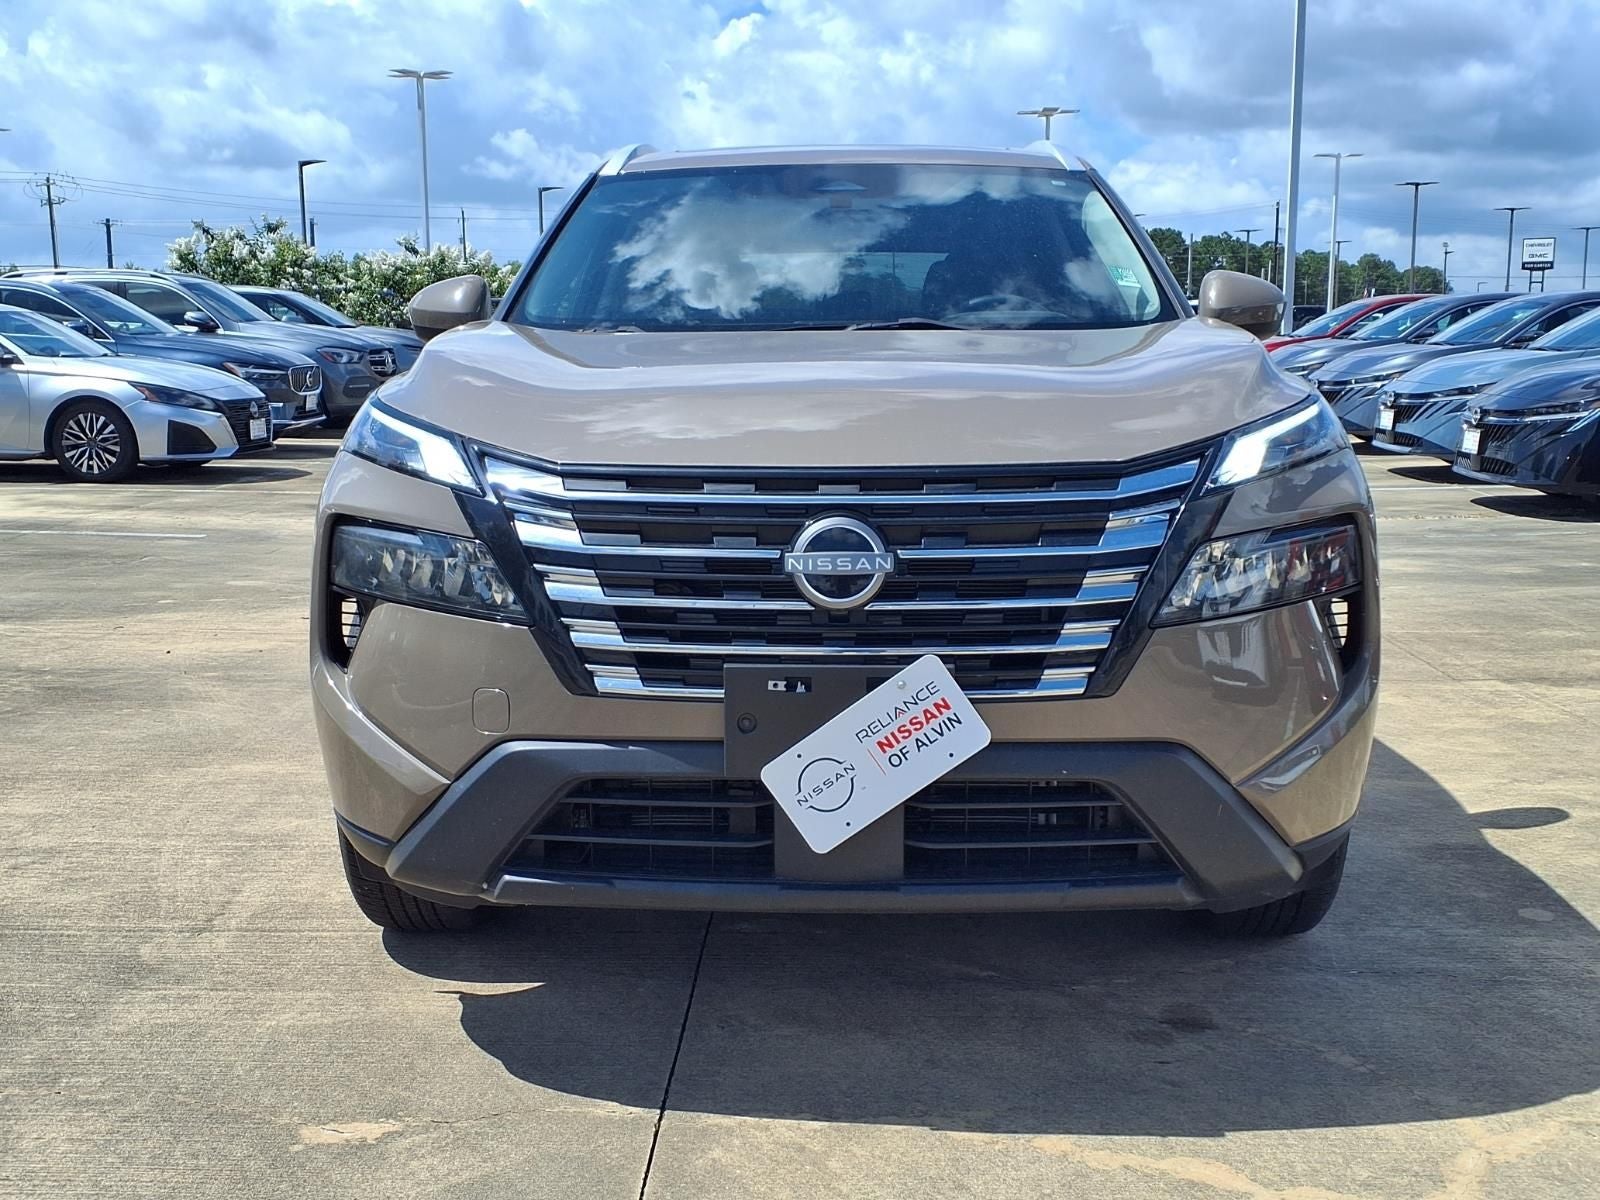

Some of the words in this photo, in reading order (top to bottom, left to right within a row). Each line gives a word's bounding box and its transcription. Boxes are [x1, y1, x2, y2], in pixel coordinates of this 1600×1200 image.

[788, 557, 891, 571] NISSAN
[855, 680, 941, 744] RELIANCE
[876, 697, 953, 755] NISSAN
[888, 747, 913, 769] OF
[915, 712, 963, 753] ALVIN
[797, 763, 856, 807] NISSAN
